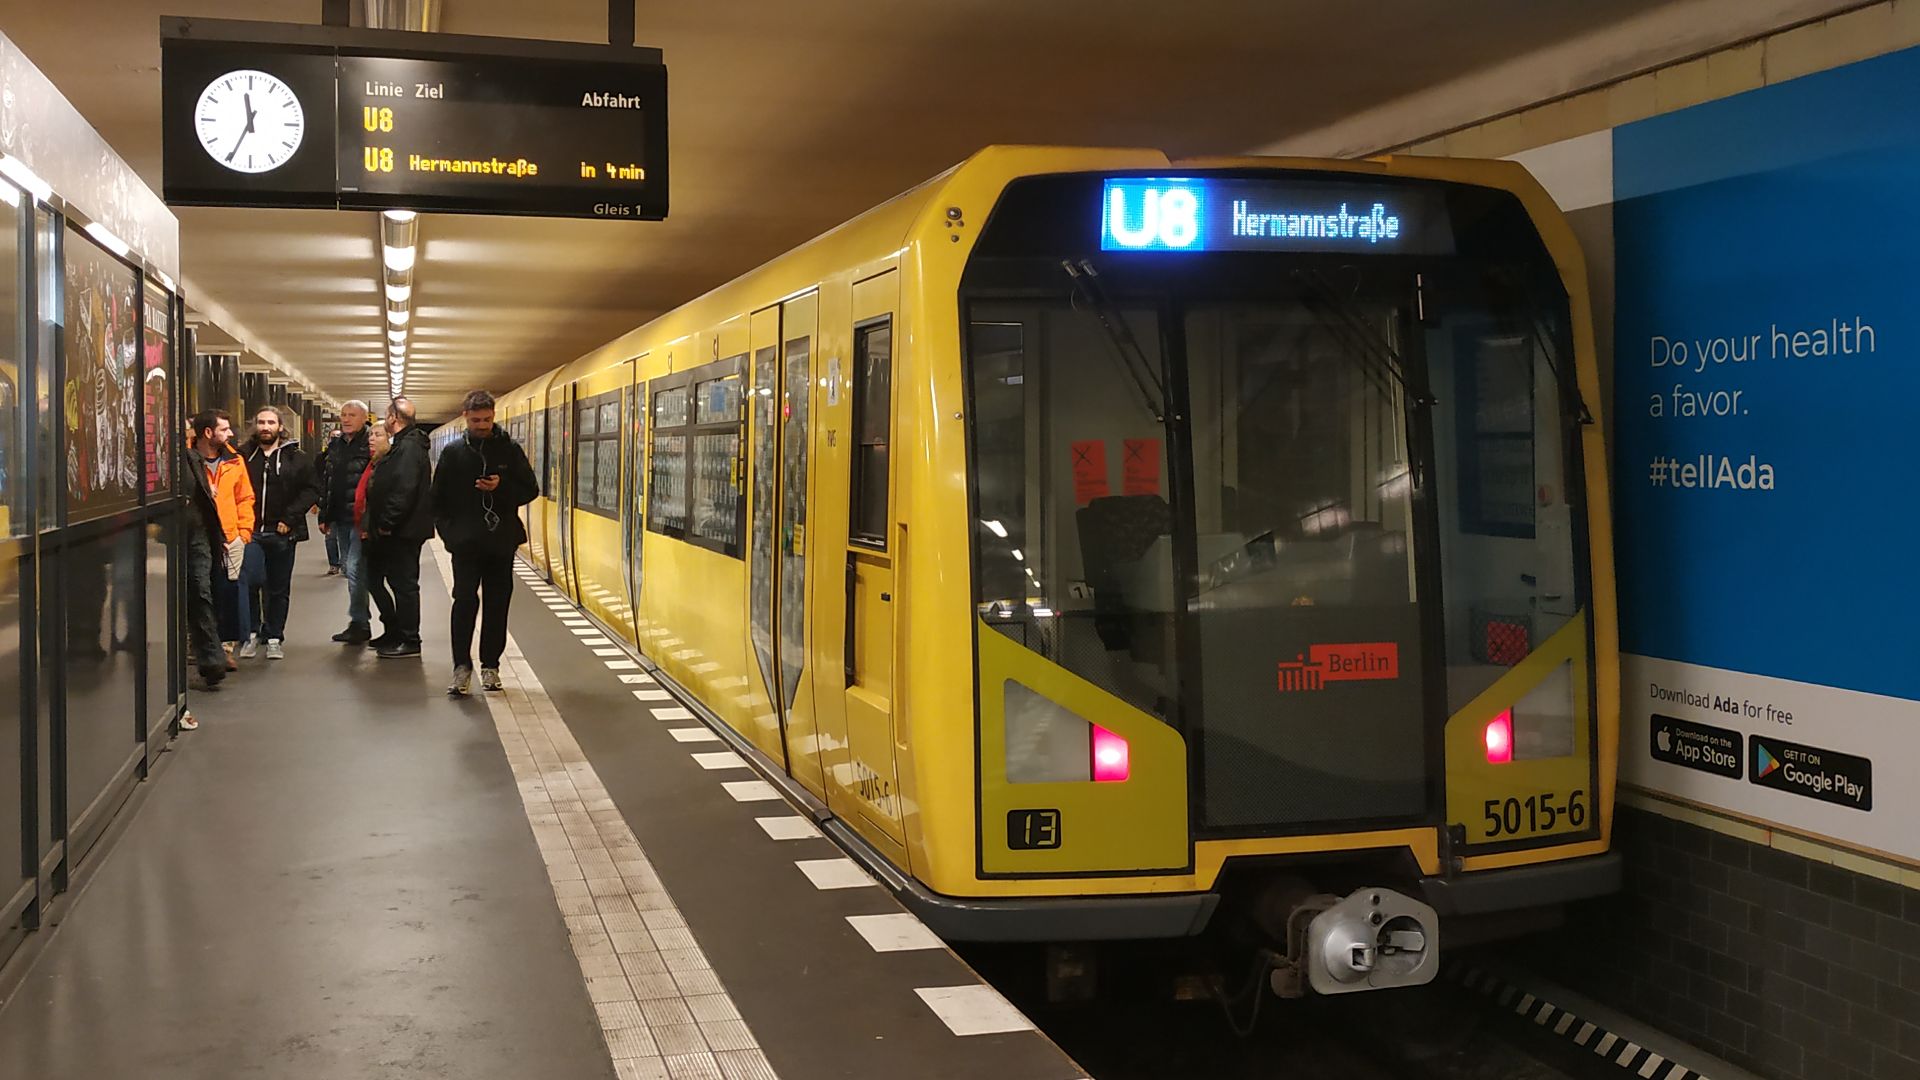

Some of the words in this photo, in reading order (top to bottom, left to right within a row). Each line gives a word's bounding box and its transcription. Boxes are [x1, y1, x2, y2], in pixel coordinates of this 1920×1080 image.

[366, 81, 403, 97] Linie
[415, 83, 443, 99] Ziel
[581, 92, 641, 109] Abfahrt
[363, 106, 393, 132] U8
[364, 146, 394, 172] U8
[409, 154, 538, 178] Hermannstraße
[580, 161, 596, 178] in
[606, 162, 617, 179] 4
[618, 164, 645, 180] min
[593, 203, 630, 216] Gleis
[635, 204, 642, 216] 1
[1109, 186, 1199, 248] U8
[1233, 200, 1399, 244] Hermannstraße
[1650, 335, 1688, 368] Do
[1694, 333, 1761, 373] your
[1771, 316, 1876, 360] health
[1650, 392, 1663, 418] a
[1671, 383, 1749, 418] favor.
[1649, 454, 1775, 490] #tellAda
[1328, 652, 1389, 673] Berlin
[1650, 683, 1710, 709] Download
[1713, 695, 1740, 715] Ada
[1742, 700, 1762, 719] for
[1766, 704, 1793, 726] free
[1675, 727, 1708, 744] Download
[1709, 736, 1720, 746] on
[1719, 737, 1732, 749] the
[1675, 739, 1700, 763] App
[1702, 745, 1736, 769] Store
[1783, 749, 1799, 761] GET
[1799, 752, 1807, 763] IT
[1807, 754, 1820, 766] ON
[1783, 762, 1832, 793] Google
[1834, 773, 1864, 803] Play
[1024, 811, 1057, 846] 13
[1484, 789, 1585, 837] 5015-6
